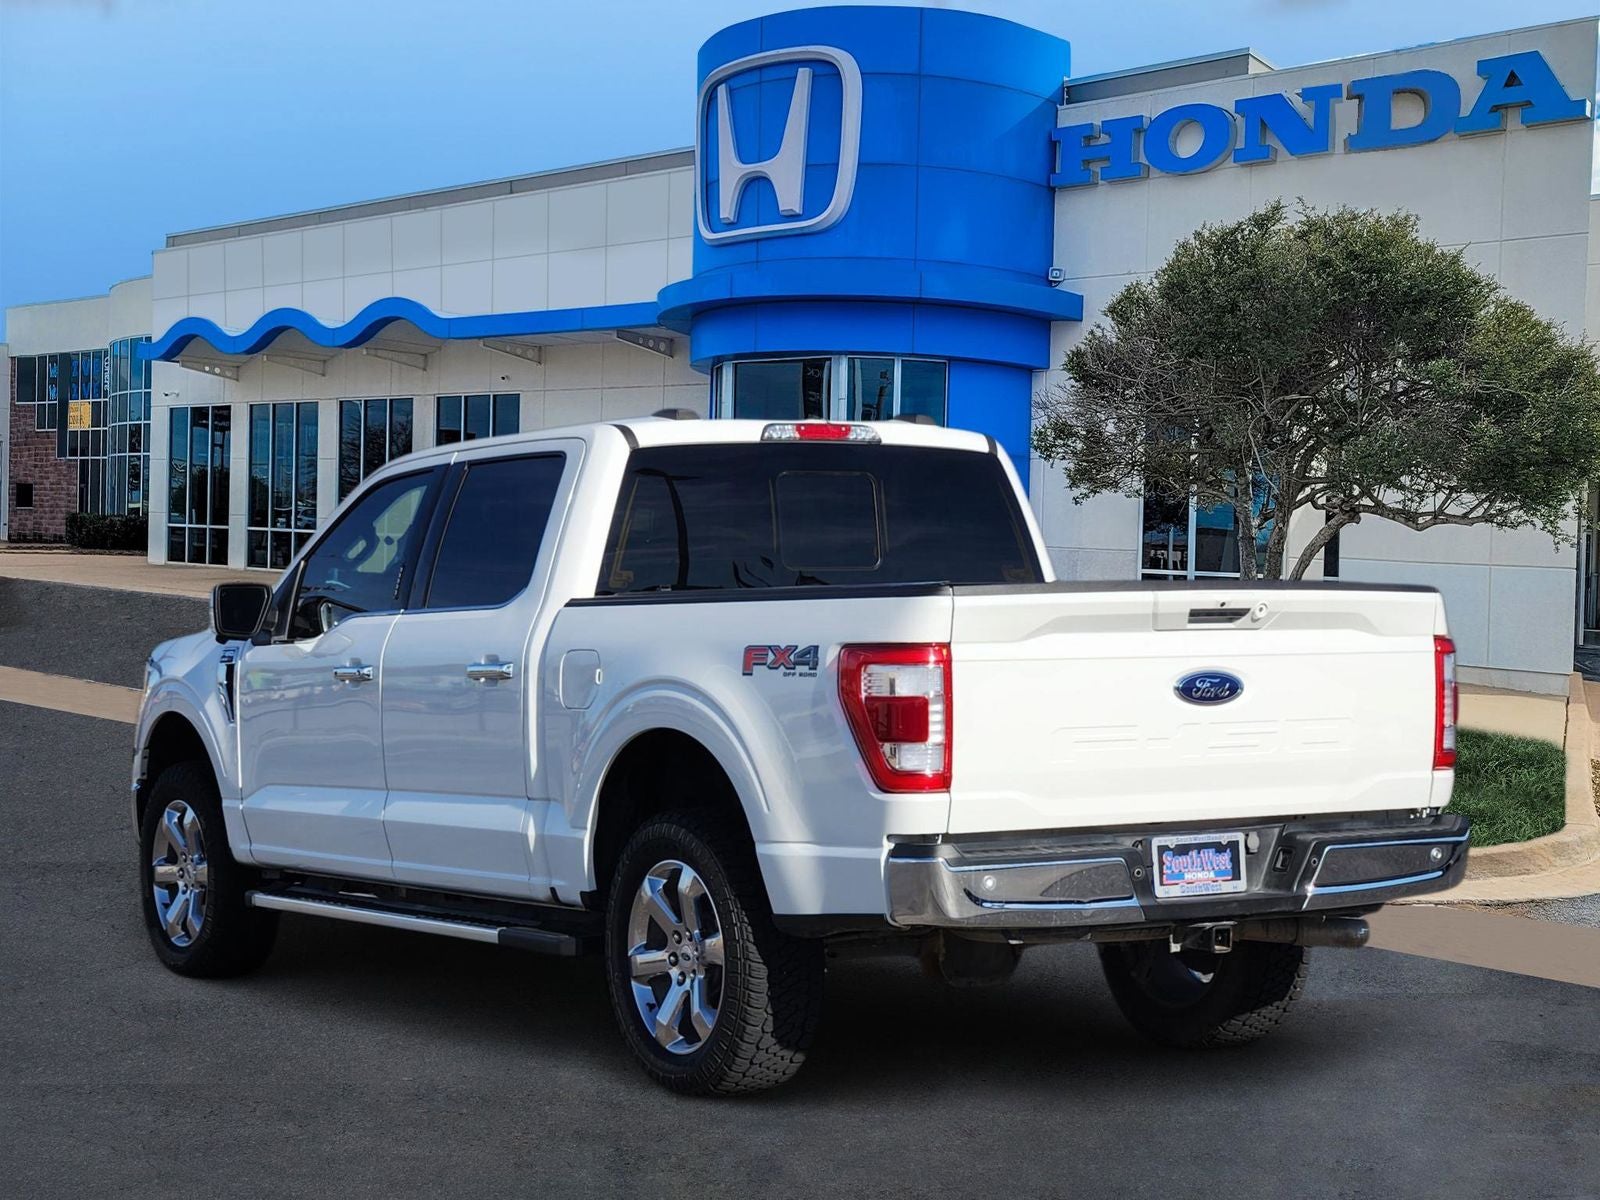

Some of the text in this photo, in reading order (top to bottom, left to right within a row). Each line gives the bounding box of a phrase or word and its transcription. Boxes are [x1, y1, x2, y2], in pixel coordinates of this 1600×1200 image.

[1051, 51, 1590, 187] HONDA
[742, 645, 819, 676] FX4
[1191, 677, 1230, 698] Ford
